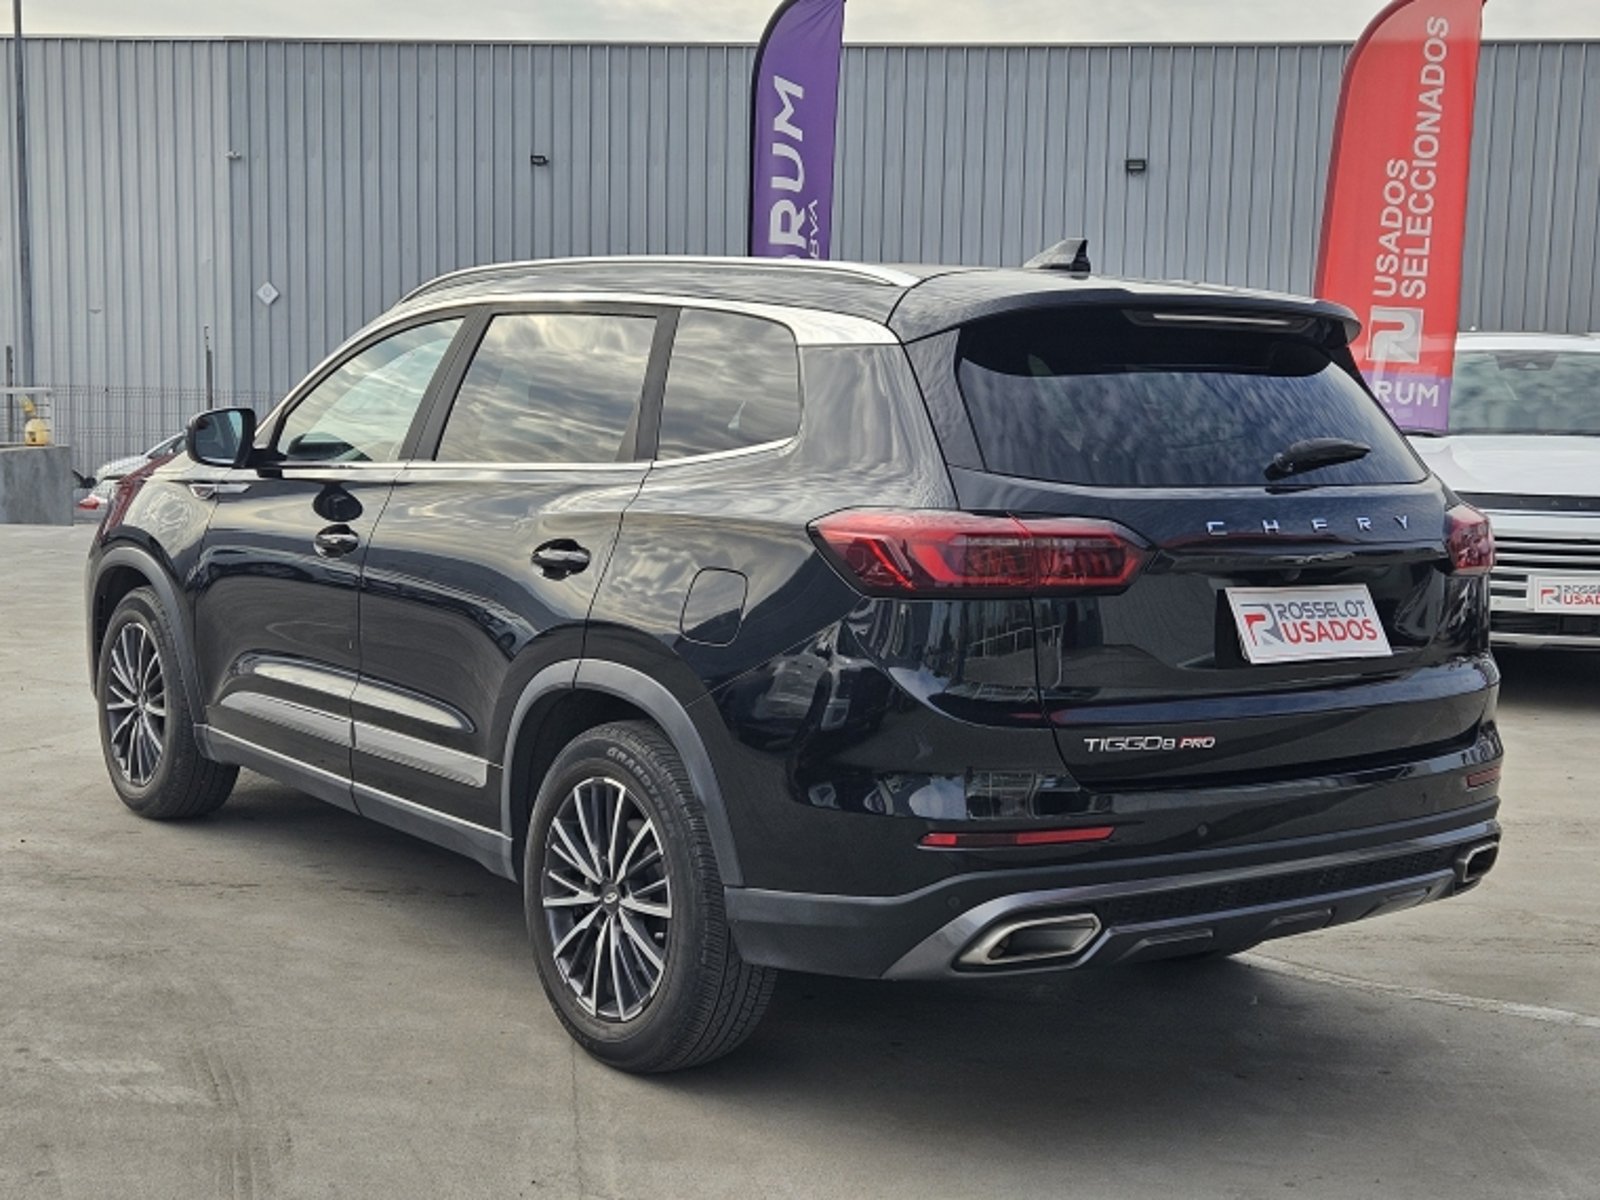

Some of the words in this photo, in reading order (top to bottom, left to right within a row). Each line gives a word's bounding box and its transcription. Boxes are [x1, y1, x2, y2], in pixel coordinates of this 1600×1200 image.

[768, 75, 807, 258] RUM
[1402, 15, 1449, 300] SELECCIONADOS
[1372, 157, 1409, 298] USADOS
[1206, 515, 1408, 536] CHERY
[1275, 600, 1368, 621] ROSSELOT
[1281, 618, 1378, 644] USADOS
[1179, 736, 1216, 749] PRO
